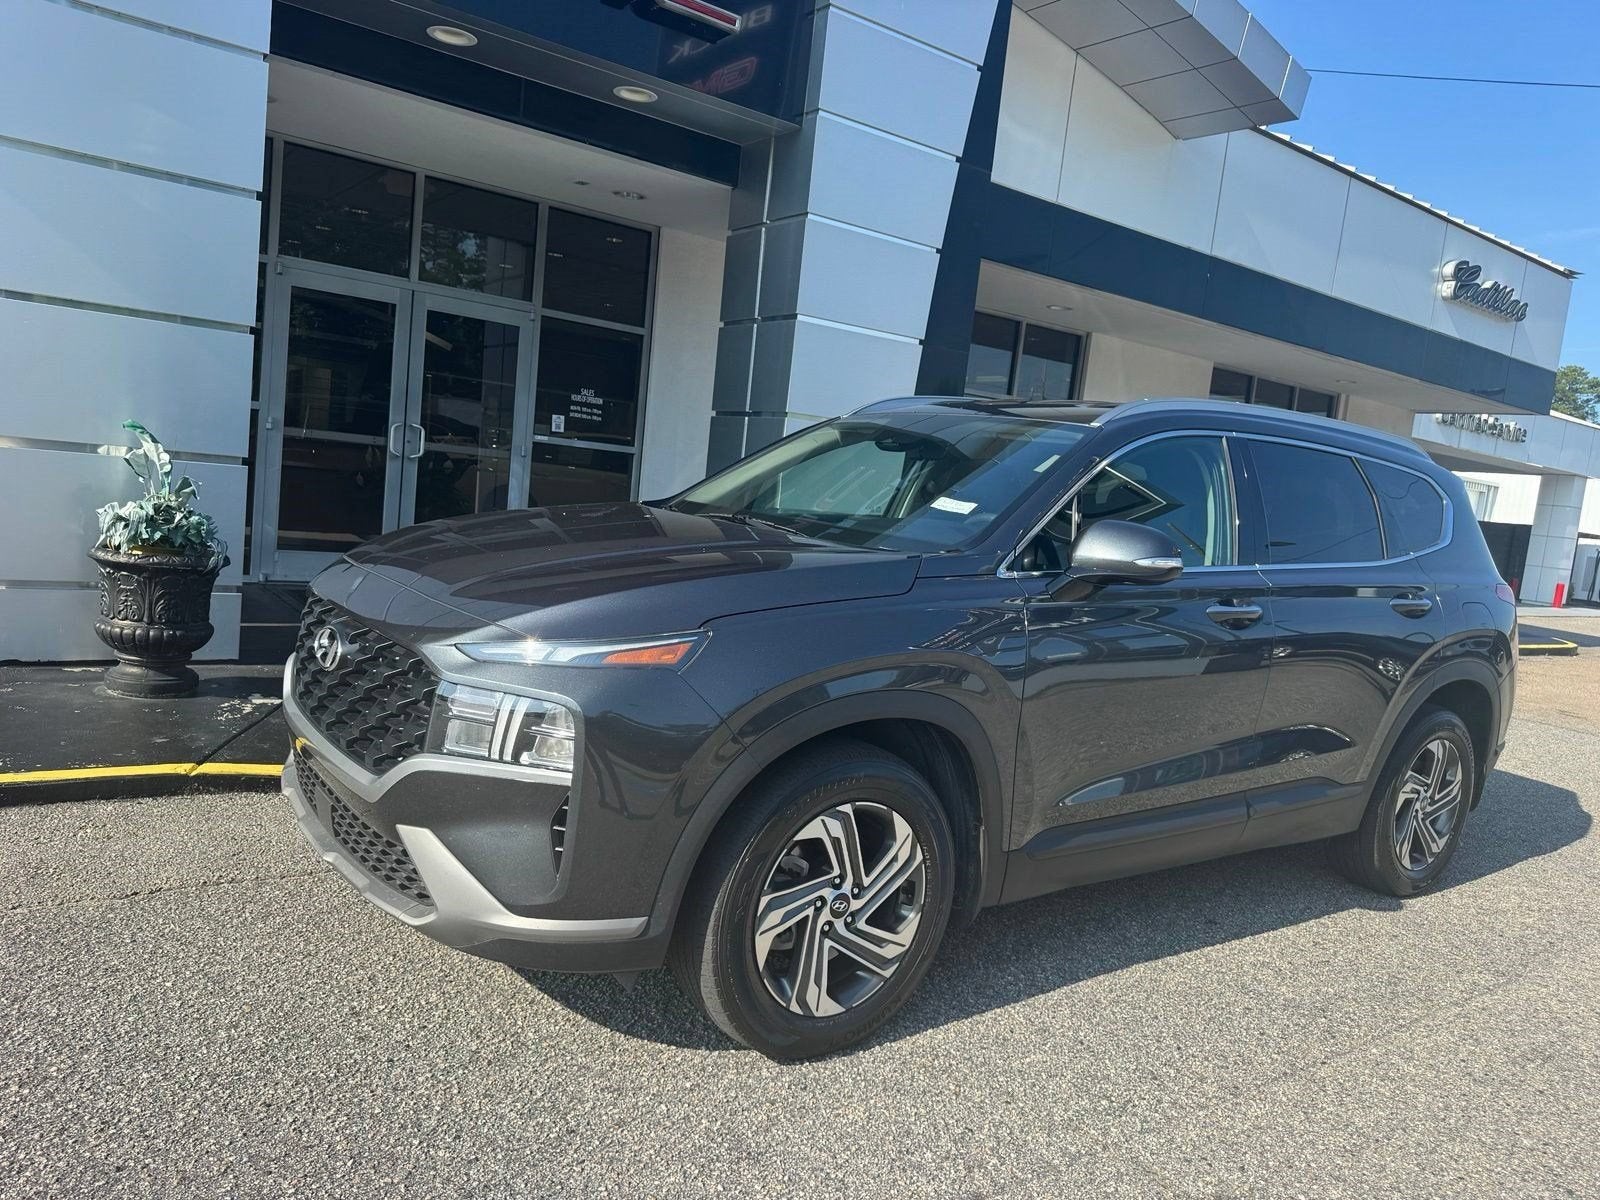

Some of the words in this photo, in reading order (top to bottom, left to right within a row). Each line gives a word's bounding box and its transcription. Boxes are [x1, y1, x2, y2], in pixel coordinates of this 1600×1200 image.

[1442, 260, 1529, 322] Cadillac
[581, 388, 595, 397] SALES
[1489, 417, 1528, 442] Service
